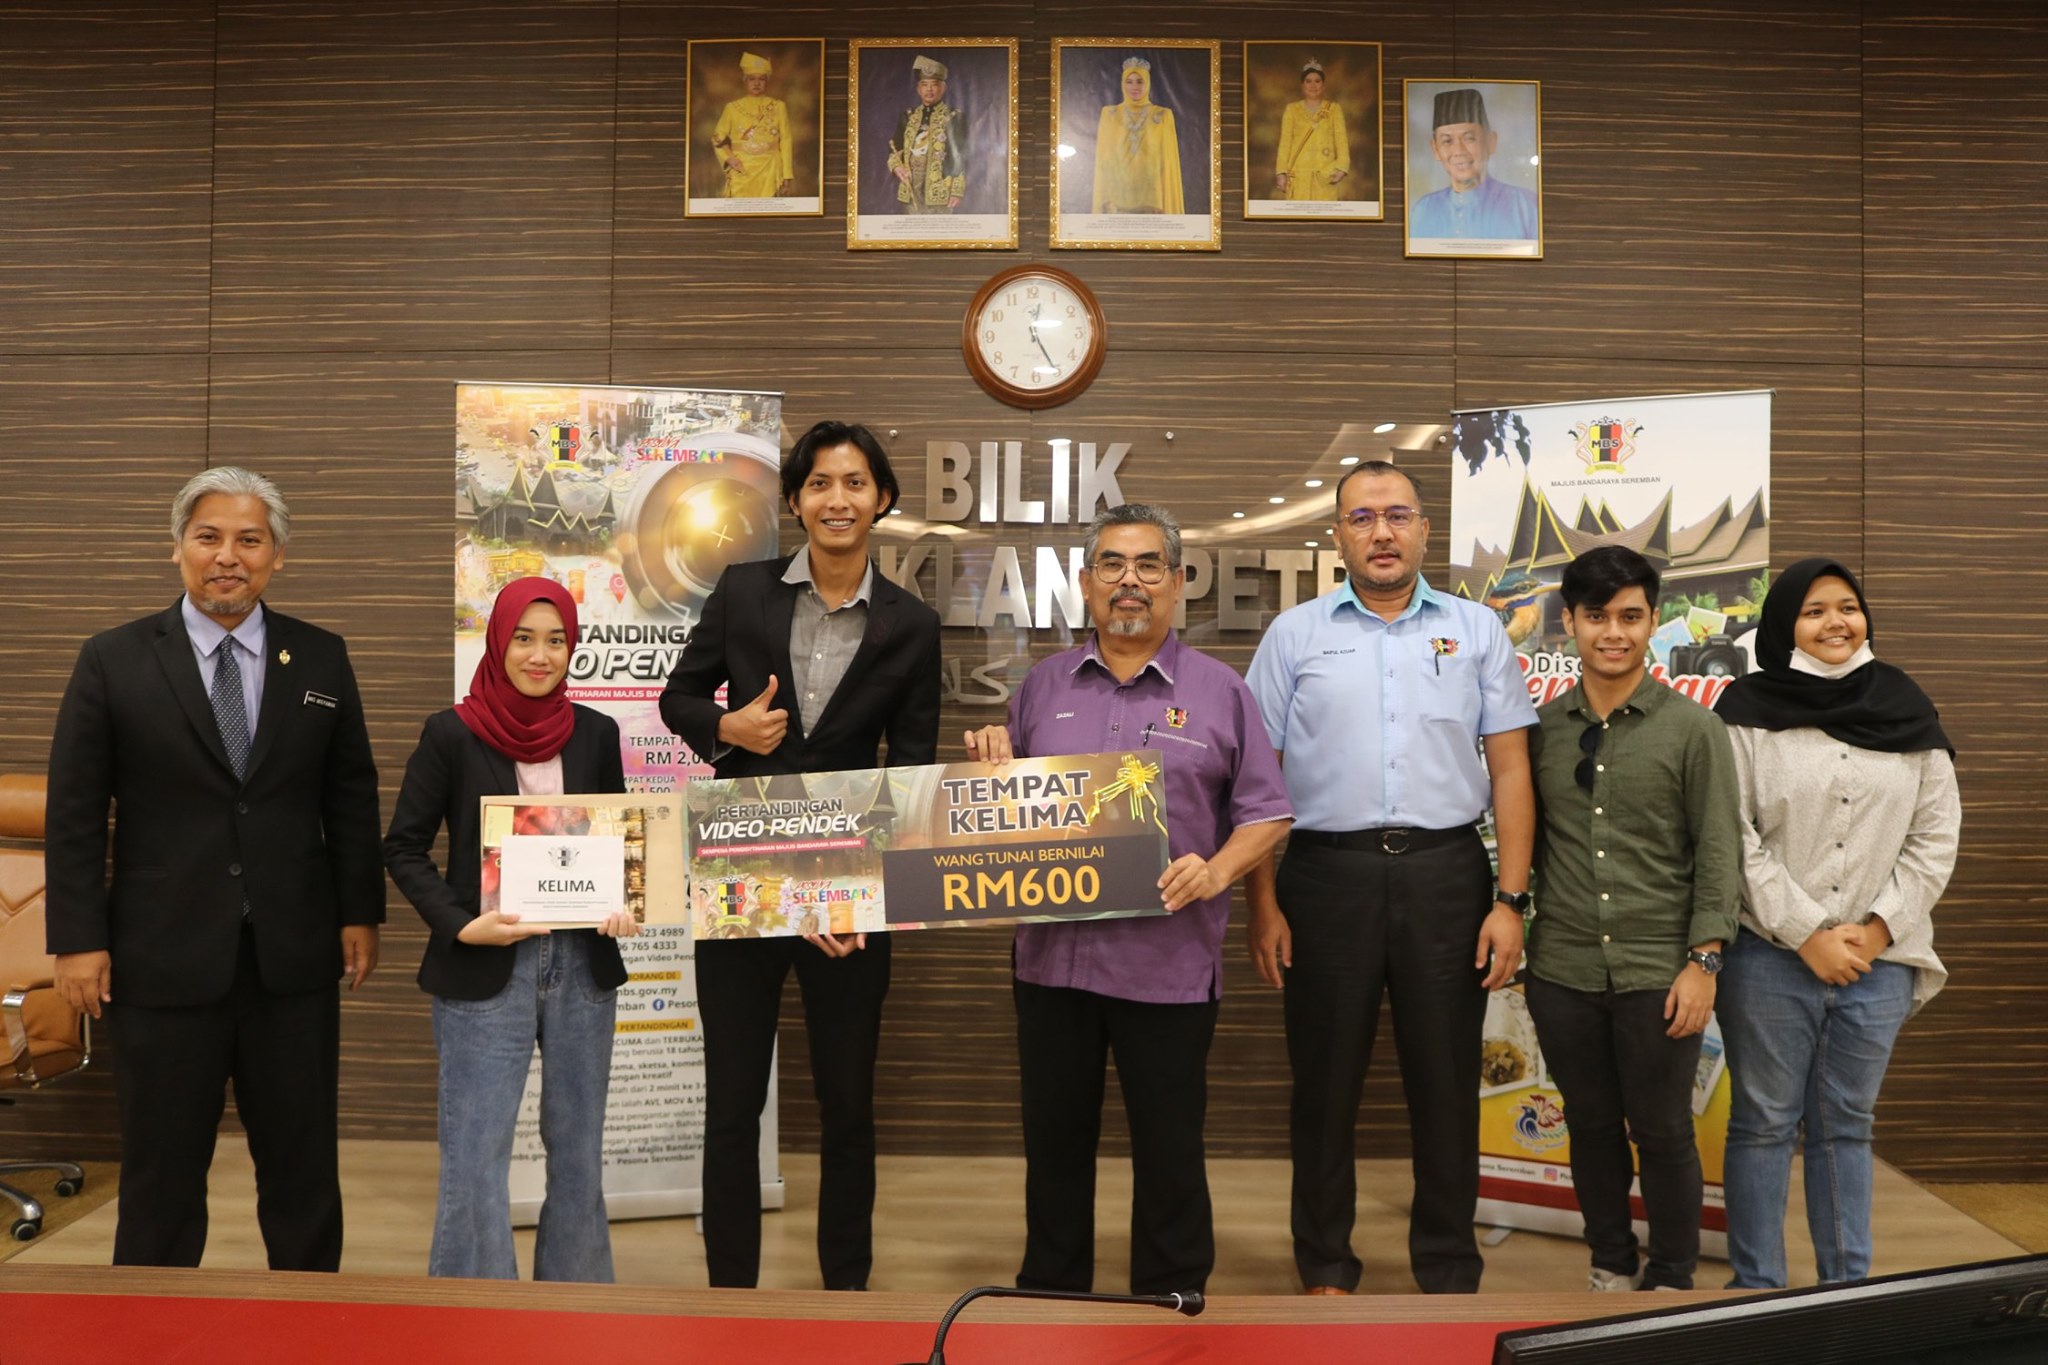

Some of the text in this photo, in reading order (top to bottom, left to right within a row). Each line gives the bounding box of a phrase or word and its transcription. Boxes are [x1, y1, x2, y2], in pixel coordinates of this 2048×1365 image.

[1026, 286, 1039, 299] 12
[1051, 291, 1057, 304] 1
[1006, 293, 1018, 306] 11
[991, 310, 1004, 322] 10
[1066, 305, 1076, 318] 2
[985, 330, 995, 343] 9
[1074, 327, 1083, 339] 3
[993, 351, 1003, 364] 8
[1067, 348, 1077, 361] 4
[1010, 366, 1019, 378] 7
[551, 440, 577, 449] MBS
[1591, 439, 1619, 448] MBS
[635, 447, 724, 464] SEREMBAN
[926, 441, 1132, 524] BILIK
[1577, 478, 1619, 486] BANDARAYA
[1621, 477, 1661, 485] SEREMBAN
[880, 545, 1096, 628] KLAN
[578, 625, 693, 644] TANDING
[602, 648, 684, 680] PEN
[565, 690, 611, 698] SYTIHARAN
[613, 690, 644, 698] MAJLIS
[630, 737, 676, 746] TEMPAT
[645, 751, 708, 767] RM 2,0
[624, 776, 676, 784] MPAT KEDUA
[943, 771, 1090, 805] TEMPAT
[717, 799, 842, 819] PERTANDINGAN
[949, 802, 1089, 834] KELIMA
[698, 813, 863, 840] VIDEO PENDEK
[933, 846, 1105, 868] WANG TUNAI BERNILAI
[538, 879, 595, 893] KELIMA
[943, 865, 1100, 911] RM600
[720, 895, 743, 904] MBS
[793, 888, 873, 904] SEREMBAN
[660, 928, 684, 936] 4989
[631, 943, 649, 951] 765
[653, 941, 677, 950] 4333
[617, 1001, 645, 1011] mban
[620, 1021, 688, 1031] PERTANDINGAN
[613, 1037, 642, 1046] CUMA
[642, 1071, 672, 1079] kreatif
[605, 1123, 652, 1132] ebangsaan
[651, 1155, 695, 1163] Seremban
